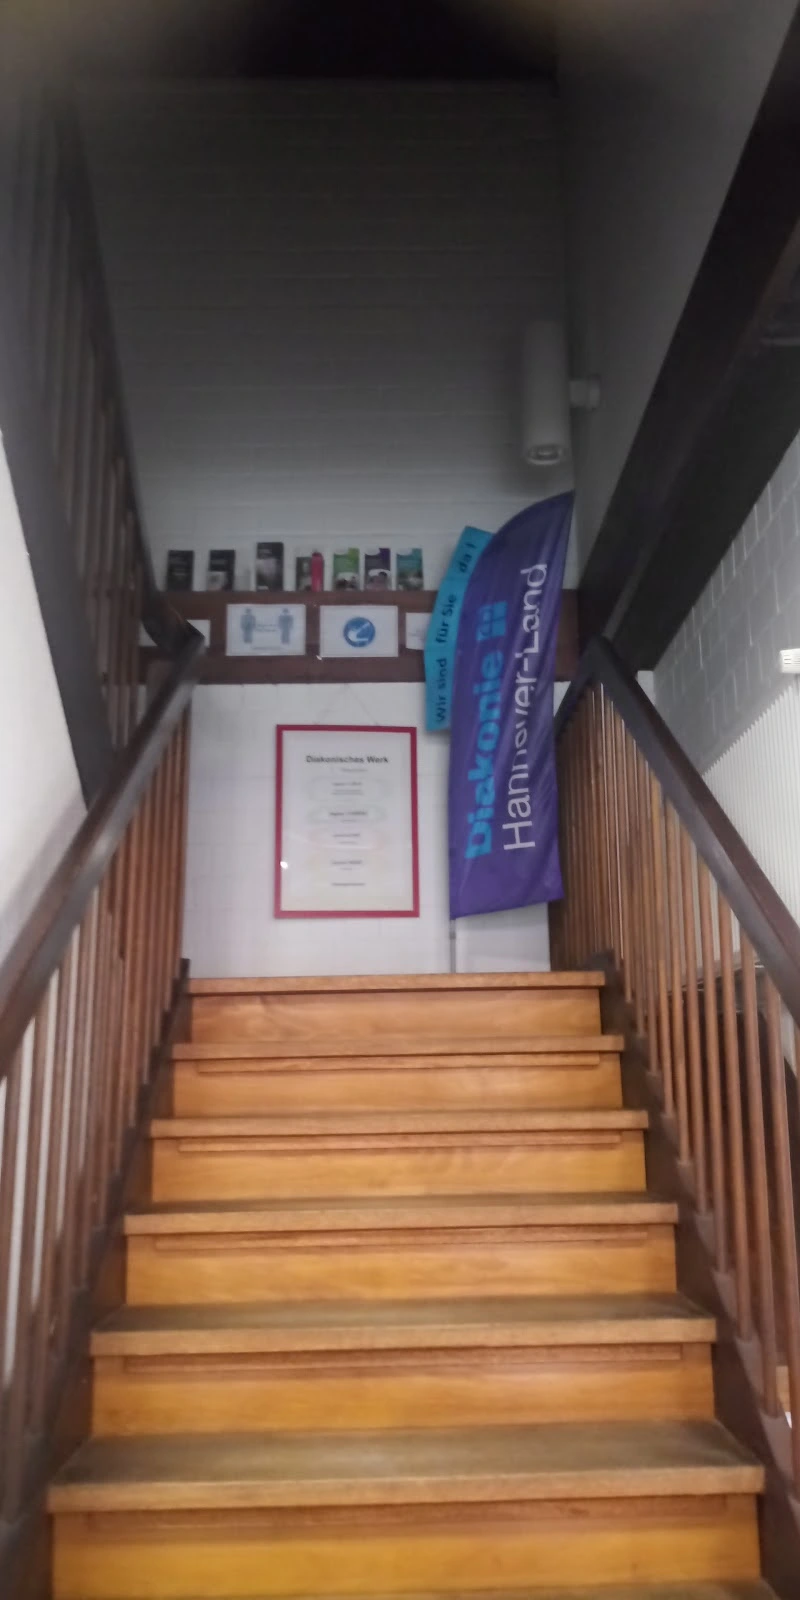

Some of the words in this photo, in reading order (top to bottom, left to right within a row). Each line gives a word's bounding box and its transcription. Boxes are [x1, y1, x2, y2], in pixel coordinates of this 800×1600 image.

[458, 553, 474, 574] da
[442, 594, 457, 617] Sie
[435, 622, 449, 645] für
[435, 658, 448, 689] sind
[435, 695, 447, 724] Wir
[502, 563, 548, 851] Hannover-Land
[305, 755, 365, 763] Diakonisches
[366, 755, 389, 764] Werk
[464, 651, 505, 860] Diakonie
